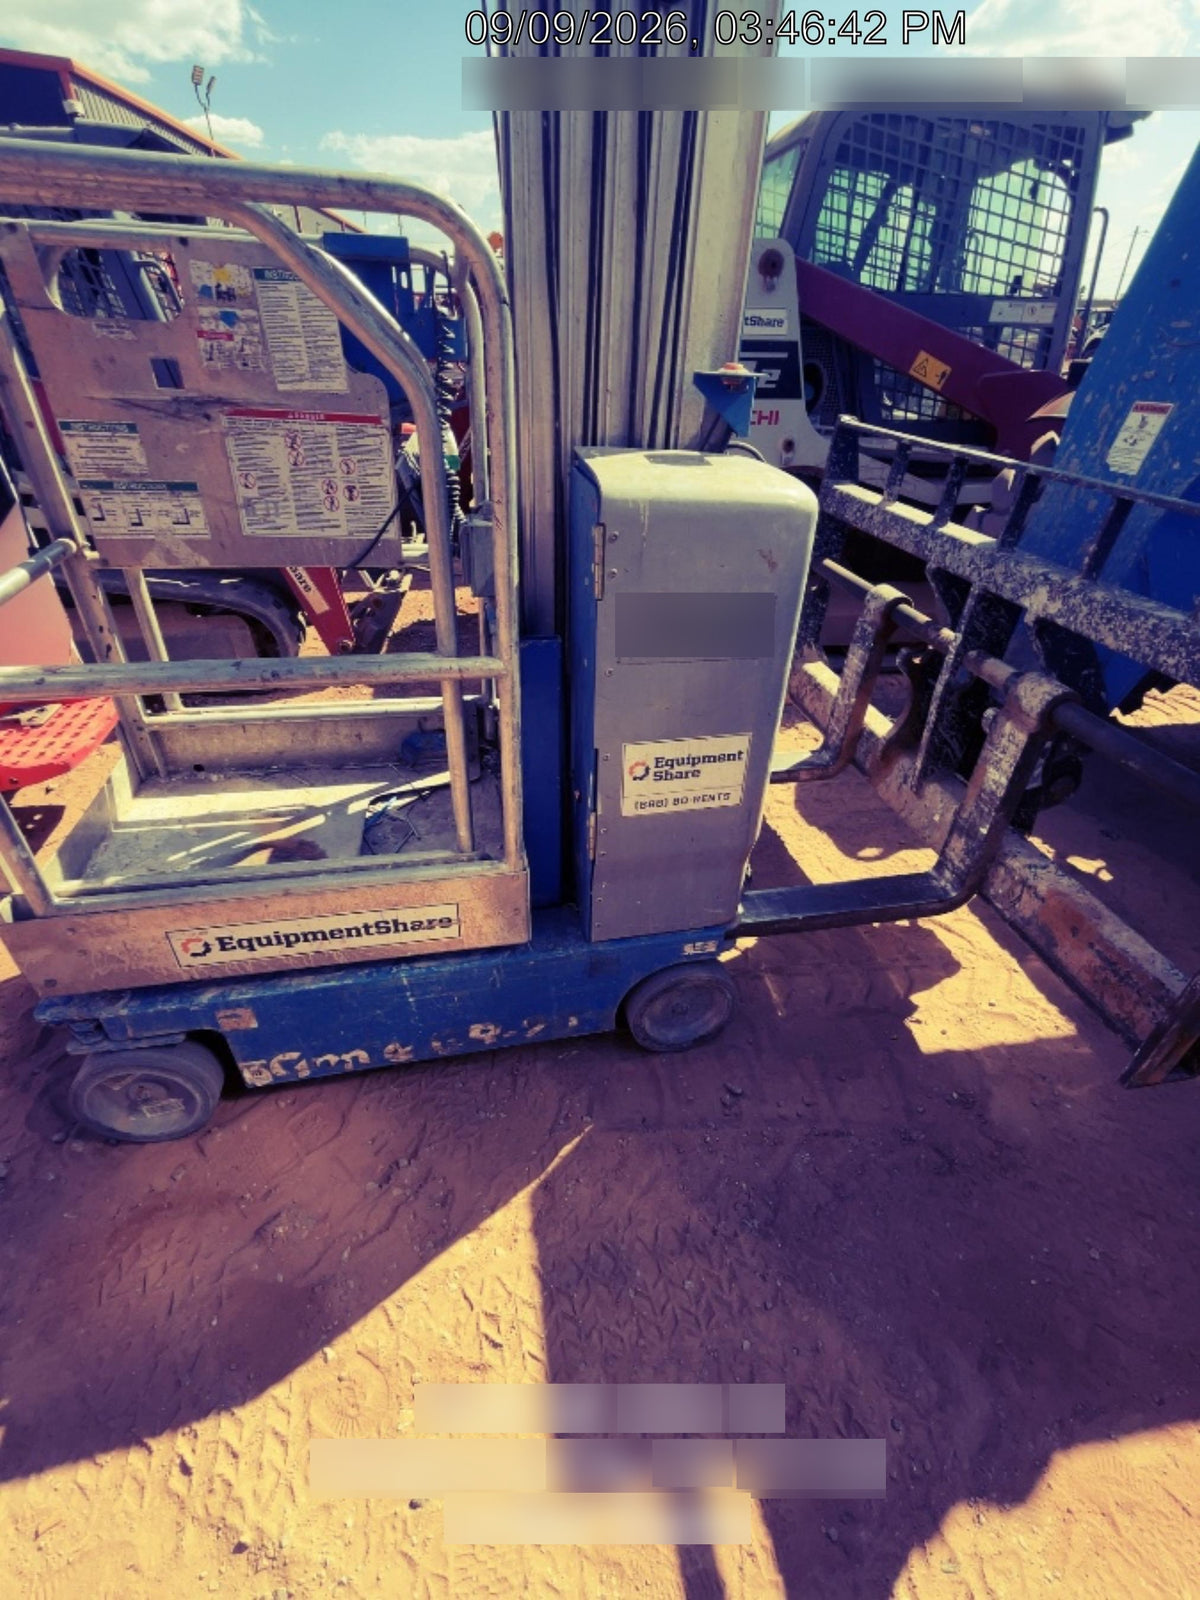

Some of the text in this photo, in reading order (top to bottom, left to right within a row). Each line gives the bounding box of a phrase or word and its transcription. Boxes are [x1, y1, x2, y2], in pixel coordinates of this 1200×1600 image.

[654, 750, 744, 769] Equipment
[653, 768, 701, 782] Share
[216, 915, 453, 952] EquipmentShare
